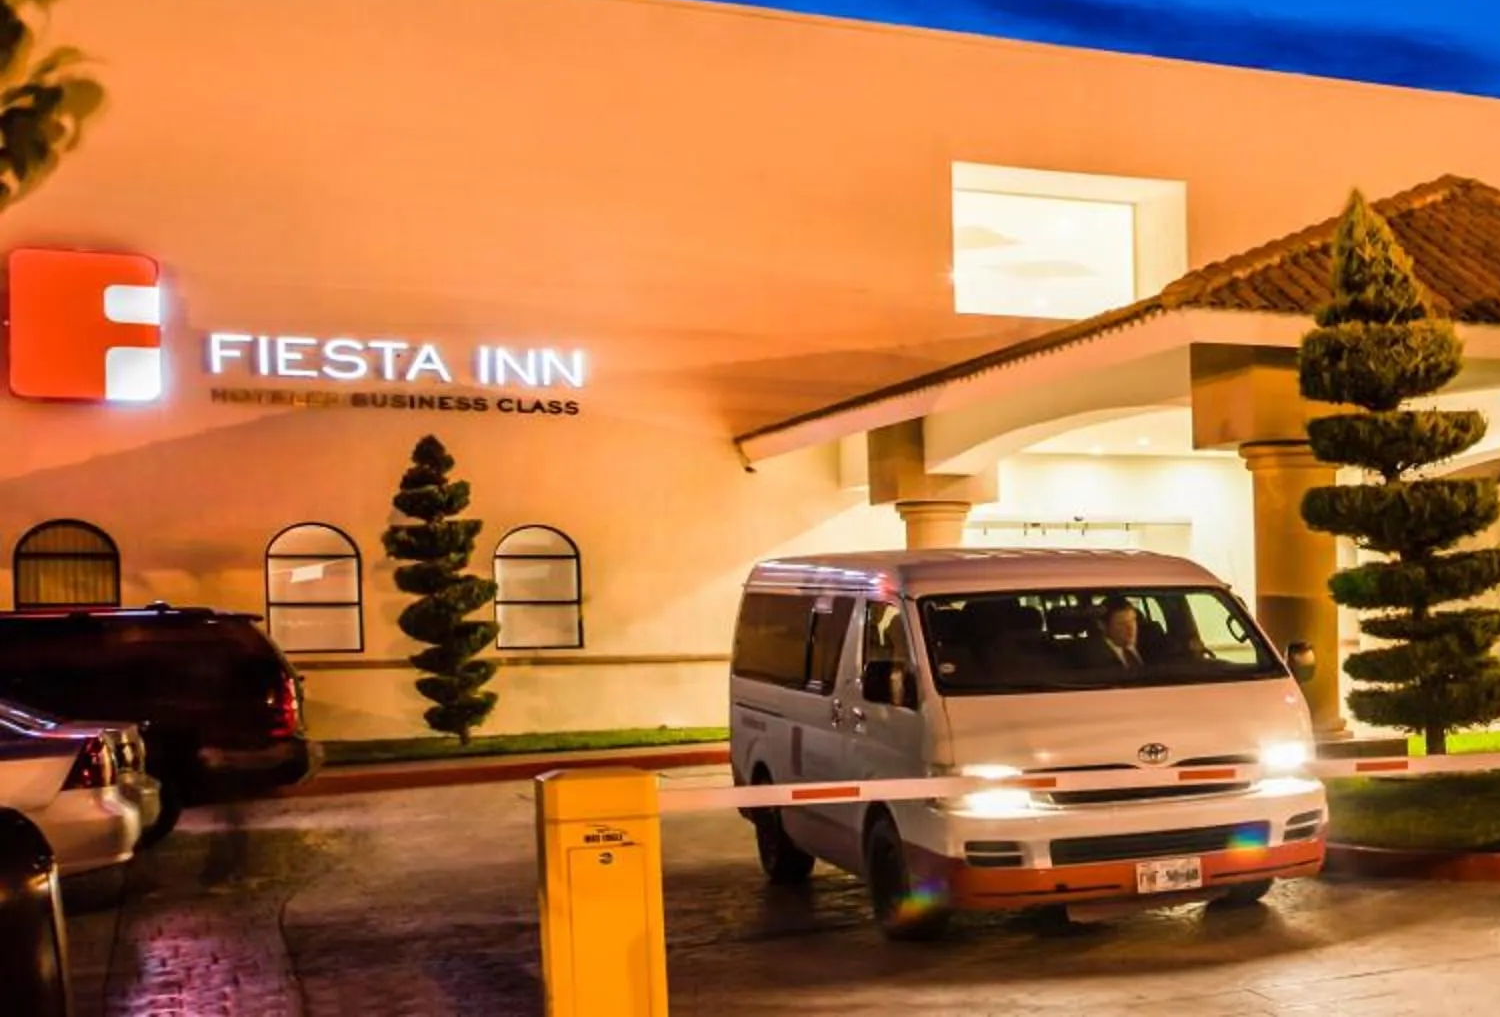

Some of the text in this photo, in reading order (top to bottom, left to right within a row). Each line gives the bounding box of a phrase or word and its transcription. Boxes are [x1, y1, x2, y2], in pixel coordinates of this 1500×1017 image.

[208, 333, 584, 388] FIESTA INN
[351, 393, 488, 412] BUSINESS
[496, 398, 580, 416] CLASS
